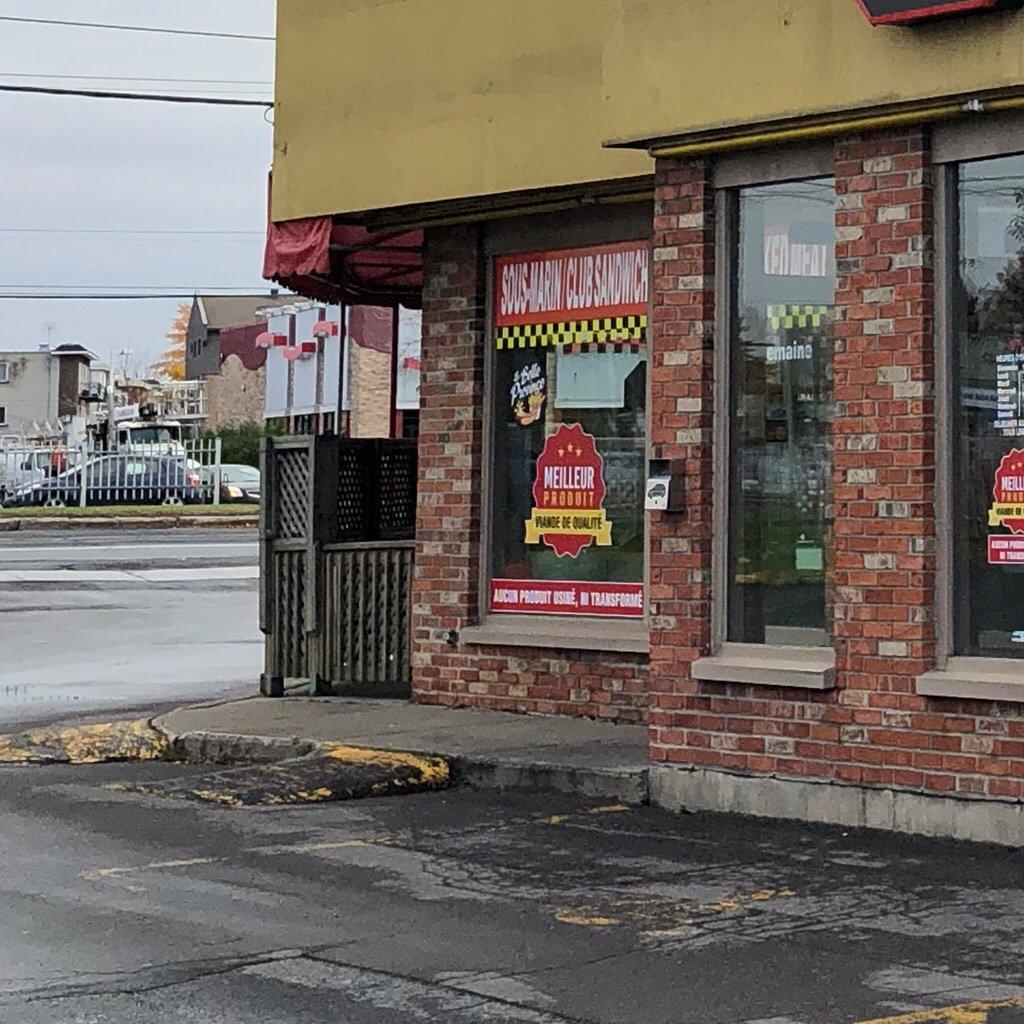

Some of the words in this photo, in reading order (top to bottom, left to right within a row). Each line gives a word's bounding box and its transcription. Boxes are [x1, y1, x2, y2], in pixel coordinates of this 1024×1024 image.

[501, 260, 562, 316] SOUS-MARIN
[566, 254, 593, 310] CLUB
[594, 249, 649, 308] SANDWICH
[544, 466, 595, 489] MEILLEUR
[543, 491, 595, 507] PRODUIT
[535, 516, 560, 529] VIANDE
[562, 516, 571, 529] DE
[573, 512, 603, 530] QUALITÉ
[519, 590, 551, 604] PRODUIT
[591, 590, 643, 608] TRANSFORMÉ
